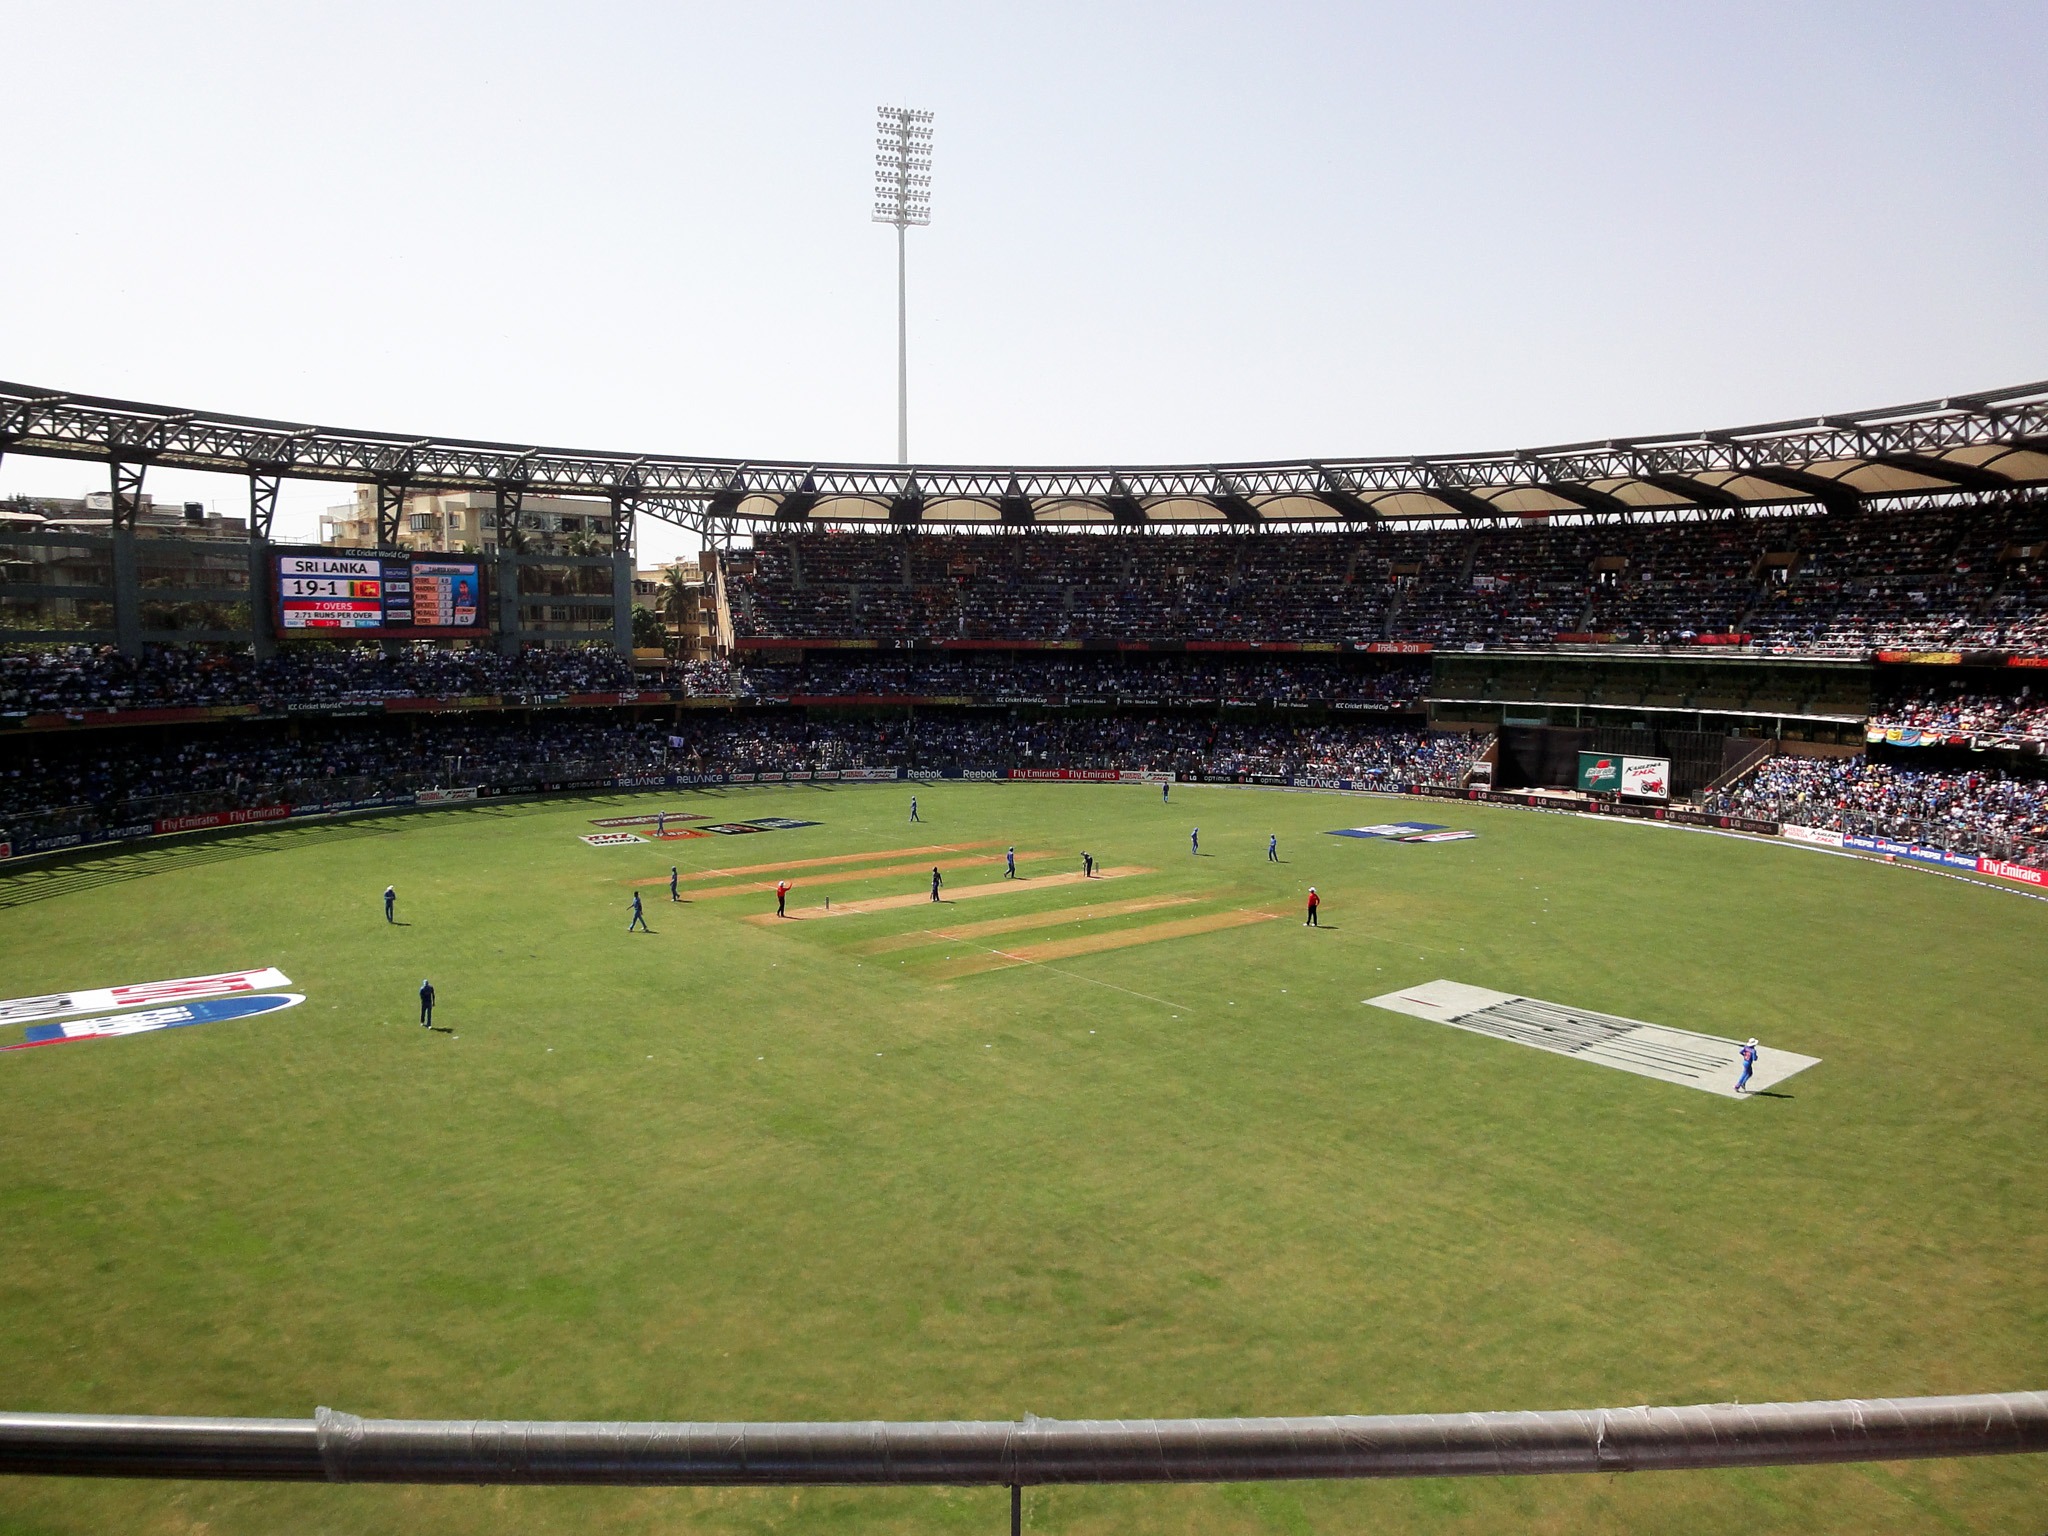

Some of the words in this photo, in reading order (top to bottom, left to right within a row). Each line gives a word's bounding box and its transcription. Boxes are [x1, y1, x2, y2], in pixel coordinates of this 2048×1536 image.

[356, 549, 377, 557] Cricket
[397, 552, 410, 560] Cup
[295, 560, 319, 573] SRI
[323, 562, 368, 574] LANKA
[293, 579, 338, 596] 19-1
[315, 602, 321, 610] 7
[323, 602, 353, 611] OVERS
[294, 611, 311, 619] 2.71
[1377, 643, 1398, 652] India
[1402, 644, 1419, 652] 2011
[520, 696, 527, 705] 2
[288, 703, 298, 711] ICC
[320, 702, 338, 710] World
[907, 769, 943, 779] Reebok
[963, 769, 998, 779] Reebok
[1013, 769, 1026, 779] Fly
[1027, 769, 1060, 778] Emirates
[1068, 769, 1081, 779] Fly
[1082, 770, 1116, 779] Emirates
[1632, 768, 1656, 777] ZMR
[1260, 777, 1287, 785] optimus
[1432, 789, 1456, 797] optimus
[1490, 794, 1515, 802] optimus
[301, 804, 321, 812] PEPSI
[1549, 799, 1576, 808] optimus
[230, 811, 245, 822] Fly
[247, 806, 285, 820] Emirates
[1600, 804, 1610, 812] LG
[1612, 805, 1640, 815] optimus
[1665, 811, 1675, 819] LG
[1677, 813, 1705, 823] optimus
[162, 820, 178, 831] Fly
[180, 814, 220, 828] Emirates
[1731, 819, 1741, 827] LG
[1744, 822, 1772, 832] optimus
[108, 824, 152, 838] HYUNDAI
[35, 834, 81, 849] HYUNDAI
[1853, 838, 1875, 849] PEPSI
[1886, 843, 1908, 854] PEPSI
[1919, 849, 1942, 861] PEPSI
[1954, 856, 1977, 867] PEPSI
[1983, 859, 1999, 877] Fly
[2000, 860, 2042, 883] Emirates
